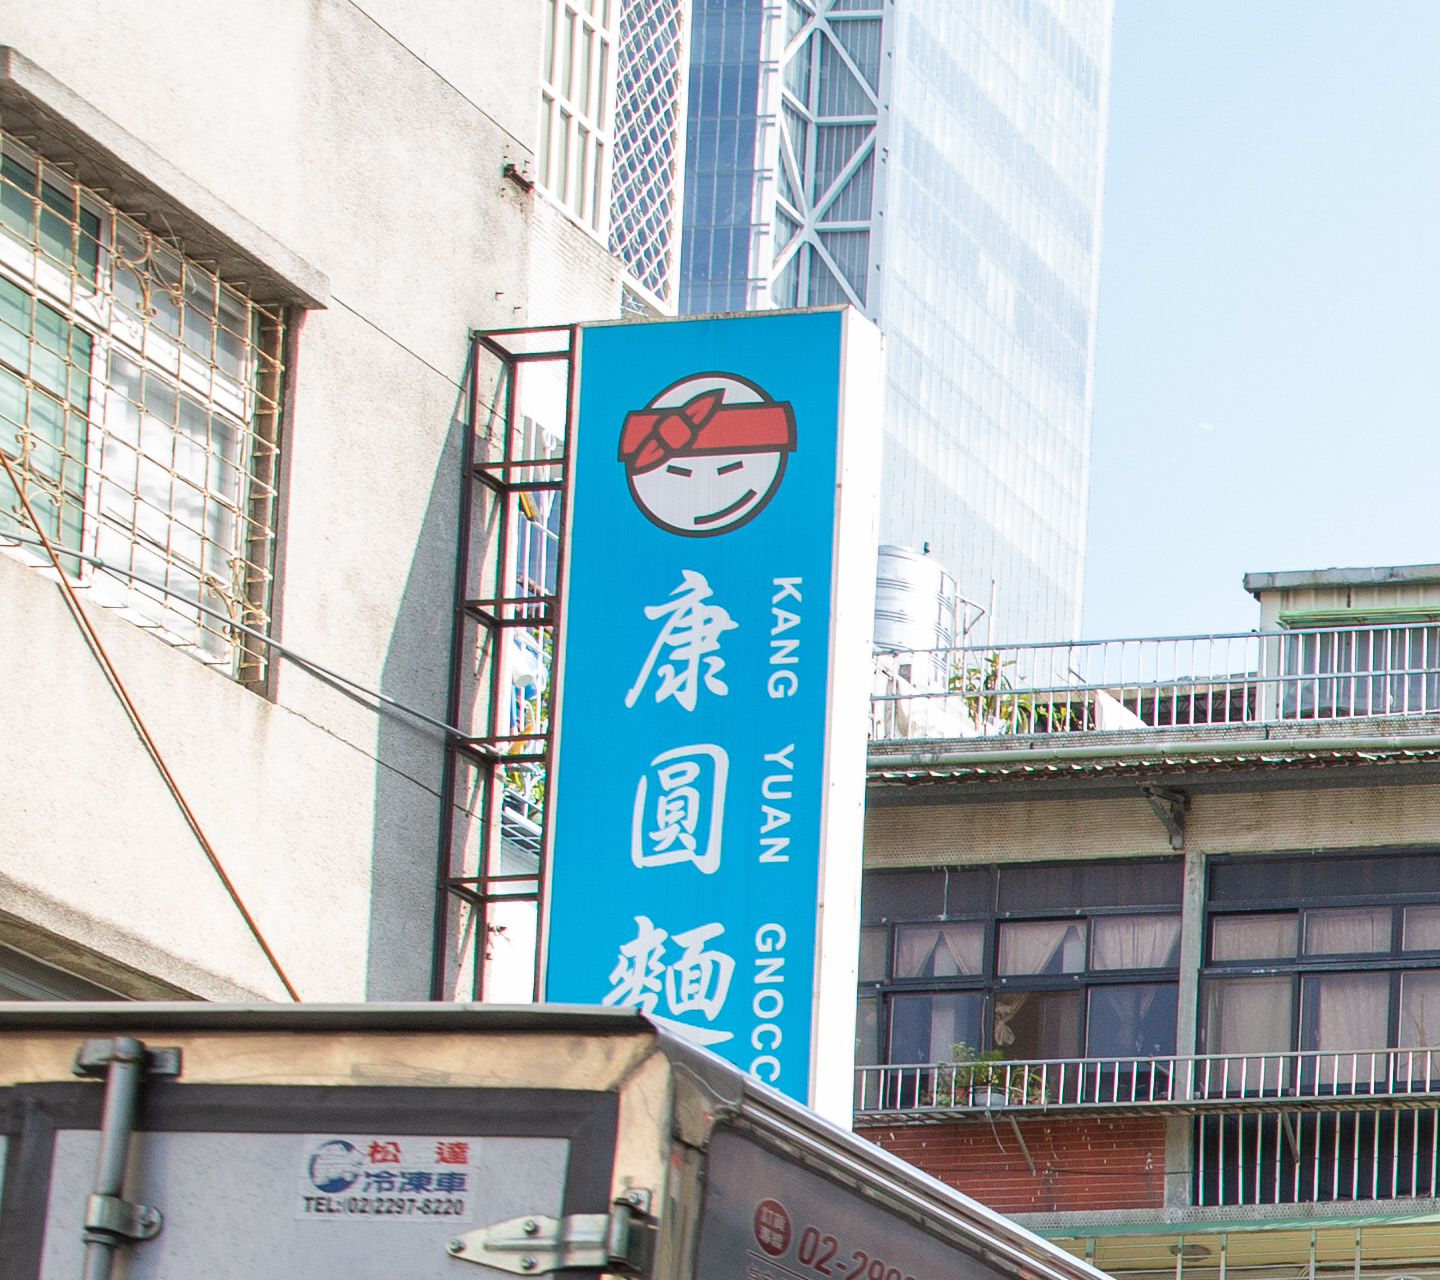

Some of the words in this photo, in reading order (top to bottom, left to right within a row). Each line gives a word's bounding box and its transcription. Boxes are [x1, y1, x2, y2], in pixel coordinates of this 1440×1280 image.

[767, 576, 803, 699] KANG
[758, 743, 795, 864] YUAN
[749, 922, 787, 1084] GNOCC
[362, 1169, 469, 1195] 冷凍車
